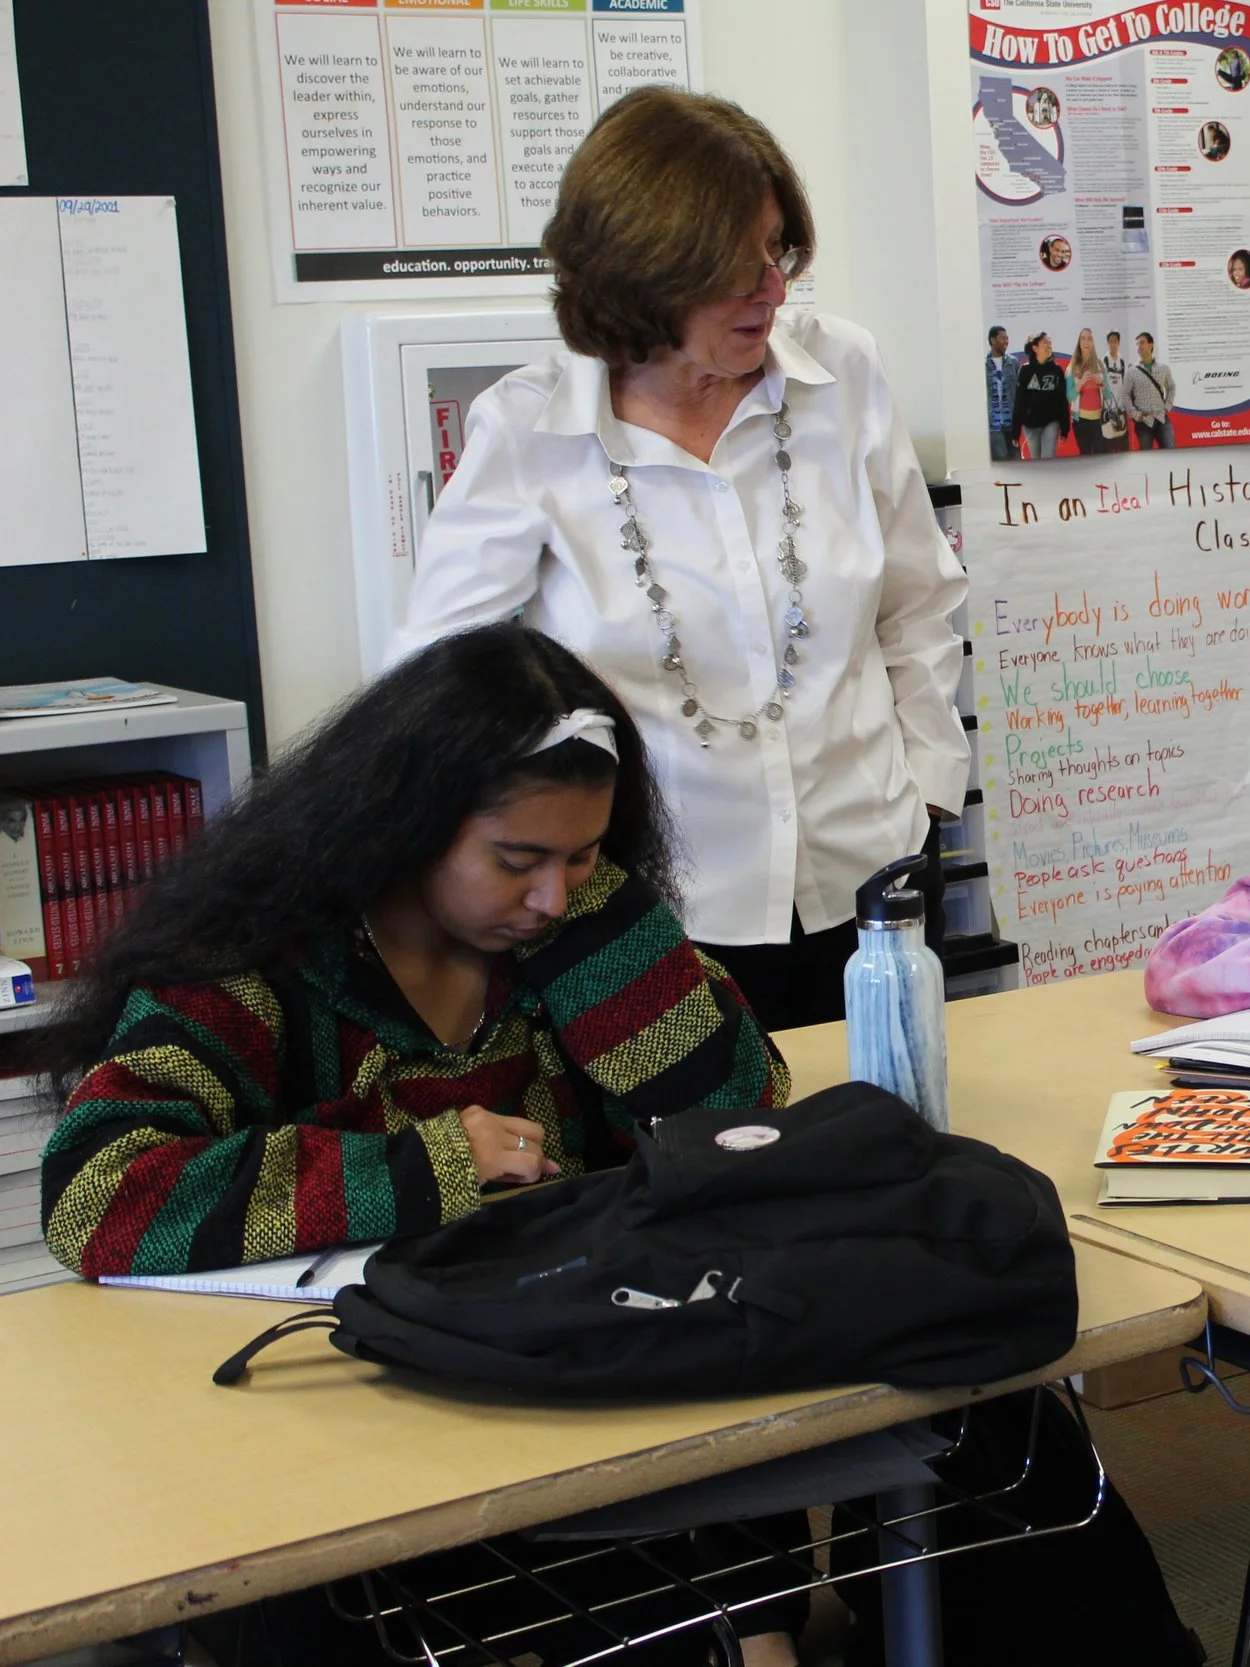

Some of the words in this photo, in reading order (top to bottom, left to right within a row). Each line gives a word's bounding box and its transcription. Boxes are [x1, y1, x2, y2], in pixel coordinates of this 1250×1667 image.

[609, 0, 668, 10] ACADEMIC
[1046, 0, 1061, 8] State
[1063, 0, 1092, 9] University
[982, 23, 1038, 64] How
[1043, 31, 1074, 63] To
[1078, 18, 1122, 58] Get
[1121, 11, 1150, 43] To
[1155, 2, 1244, 38] College
[394, 47, 414, 58] We
[416, 47, 435, 58] will
[438, 47, 467, 58] learn
[469, 49, 482, 59] to
[284, 55, 305, 66] We
[308, 54, 330, 66] will
[333, 54, 362, 66] learn
[365, 56, 378, 66] to
[395, 64, 409, 75] be
[412, 66, 447, 76] aware
[450, 64, 461, 76] of
[465, 67, 483, 76] our
[296, 73, 346, 84] discover
[350, 73, 369, 84] the
[413, 82, 470, 95] emotions,
[293, 91, 330, 102] leader
[334, 90, 376, 103] within,
[400, 100, 463, 111] understand
[467, 103, 486, 111] our
[313, 110, 359, 123] express
[412, 120, 462, 131] response
[465, 119, 477, 129] to
[302, 127, 358, 139] ourselves
[362, 127, 373, 138] in
[430, 136, 462, 147] those
[301, 147, 376, 159] empowering
[407, 154, 463, 166] emotions,
[466, 154, 487, 164] and
[312, 165, 342, 176] ways
[345, 163, 368, 174] and
[426, 171, 471, 183] practice
[301, 182, 358, 194] recognize
[361, 183, 381, 192] our
[428, 189, 472, 202] positive
[59, 199, 120, 215] 09/29/2001
[298, 200, 348, 211] inherent
[351, 199, 387, 210] value.
[422, 206, 481, 217] behaviors.
[383, 259, 450, 274] education.
[454, 256, 531, 275] opportunity.
[1204, 371, 1240, 379] BOEING
[1211, 420, 1221, 429] Go
[1222, 420, 1231, 428] to:
[994, 482, 1039, 526] In
[1059, 498, 1087, 522] an
[1095, 474, 1150, 514] Ideal
[995, 590, 1101, 644] Everybody
[1113, 601, 1129, 623] is
[1149, 570, 1203, 628] doing
[999, 649, 1061, 672] Everyone
[1073, 634, 1119, 661] knows
[1124, 631, 1161, 654] what
[1170, 627, 1196, 658] they
[1205, 629, 1226, 646] are
[1000, 669, 1032, 708] We
[1052, 659, 1118, 701] should
[1135, 655, 1190, 689] choose
[1005, 705, 1065, 733] Working
[1075, 696, 1129, 727] together,
[1135, 690, 1190, 719] learning
[1190, 679, 1243, 712] together
[1004, 728, 1084, 770] Projects
[1007, 768, 1054, 788] Sharing
[1058, 746, 1120, 781] thoughts
[1124, 752, 1140, 766] on
[1146, 739, 1185, 773] topics
[1009, 788, 1069, 819] Doing
[1077, 767, 1161, 806] research
[1128, 822, 1189, 848] Museums
[1013, 867, 1063, 890] People
[1068, 859, 1105, 880] ask
[1115, 848, 1188, 883] questions
[1017, 890, 1085, 924] Everyone
[1095, 882, 1112, 901] is
[1117, 877, 1165, 909] paying
[1169, 848, 1232, 888] attention
[1021, 943, 1078, 971] Reading
[1084, 921, 1145, 955] chapters
[1025, 966, 1060, 988] People
[1063, 964, 1085, 979] are
[1089, 943, 1143, 974] engaged
